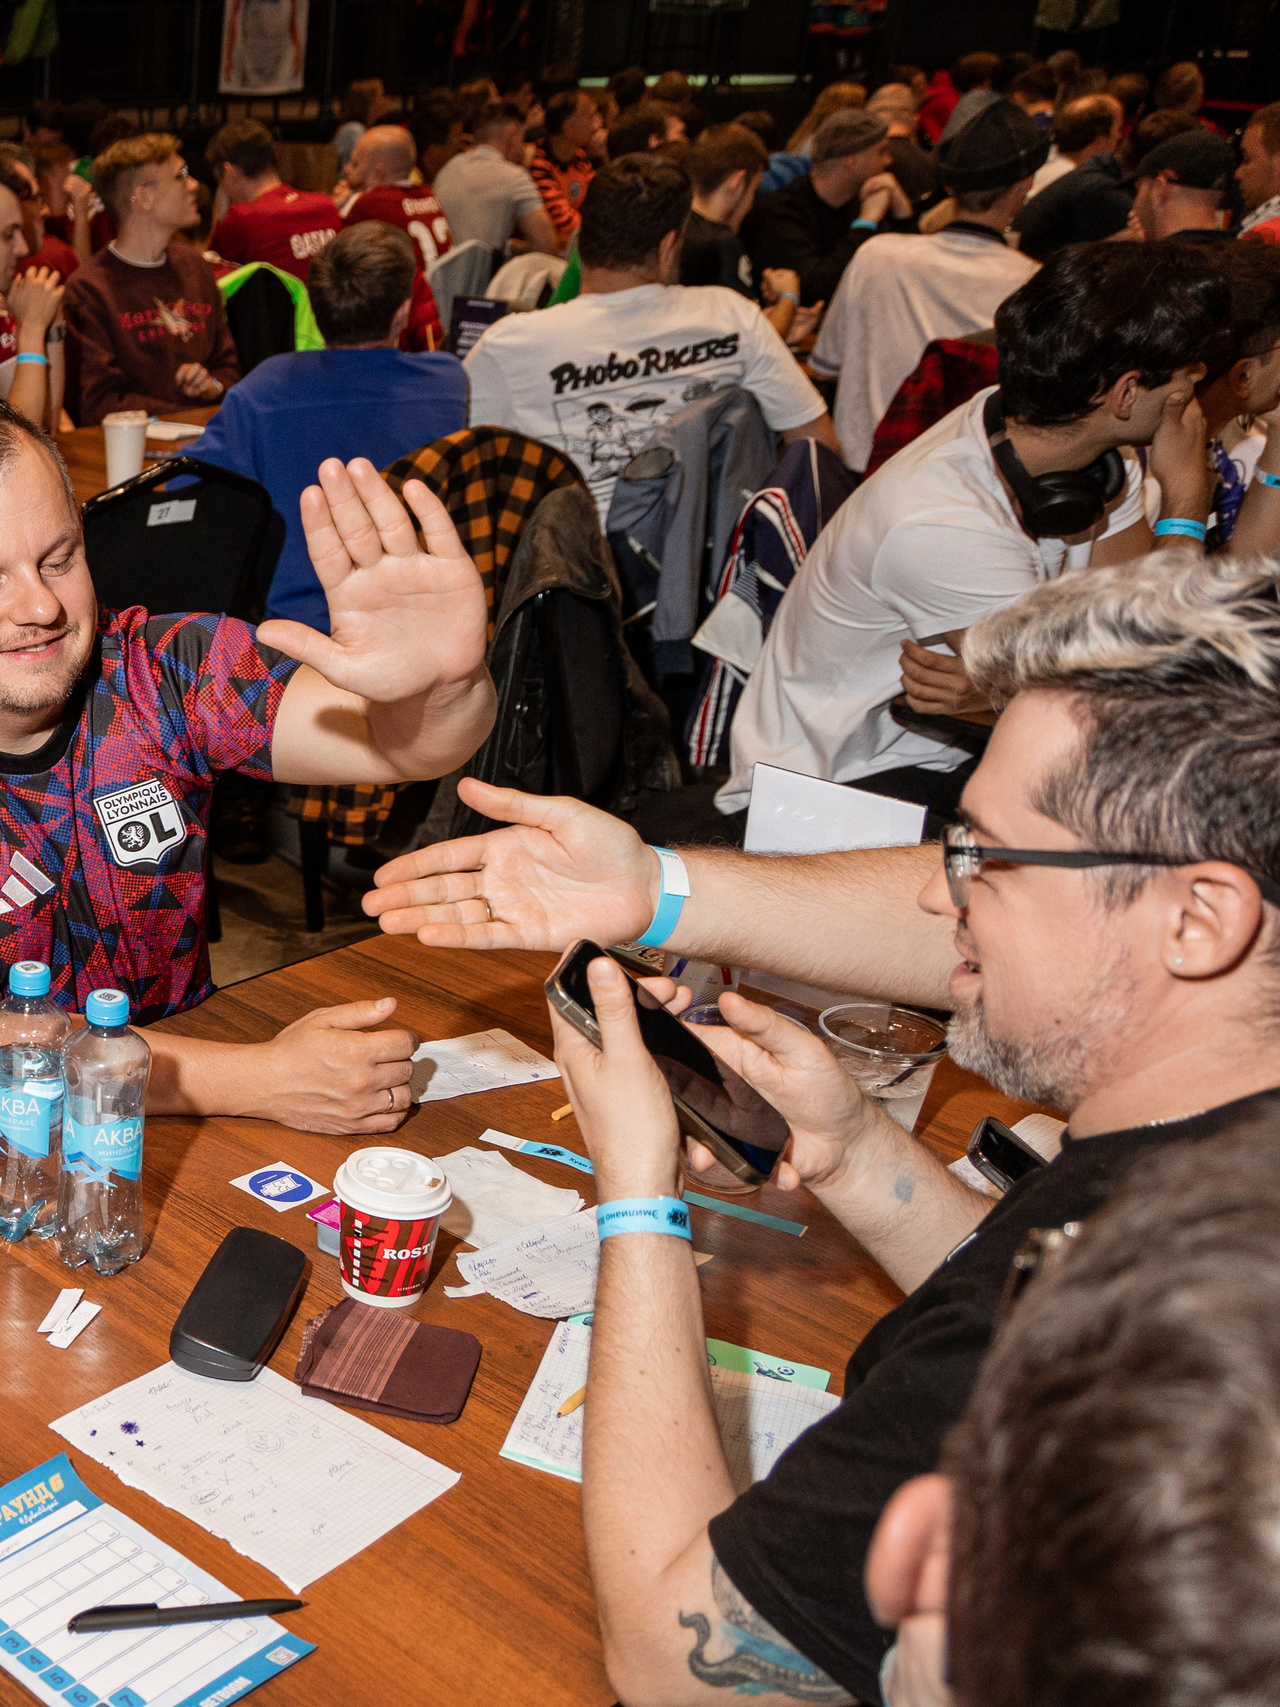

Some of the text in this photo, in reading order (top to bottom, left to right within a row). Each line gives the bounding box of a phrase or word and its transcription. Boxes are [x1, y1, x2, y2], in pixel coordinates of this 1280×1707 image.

[157, 506, 171, 519] 27
[103, 783, 165, 810] OLYMPIQUE
[106, 791, 168, 820] LYONNAIS
[605, 1209, 659, 1220] Эмилиано
[5, 1637, 20, 1649] 3
[28, 1654, 43, 1666] 4
[50, 1672, 65, 1684] 5
[73, 1691, 88, 1703] 6
[119, 1694, 134, 1706] 7
